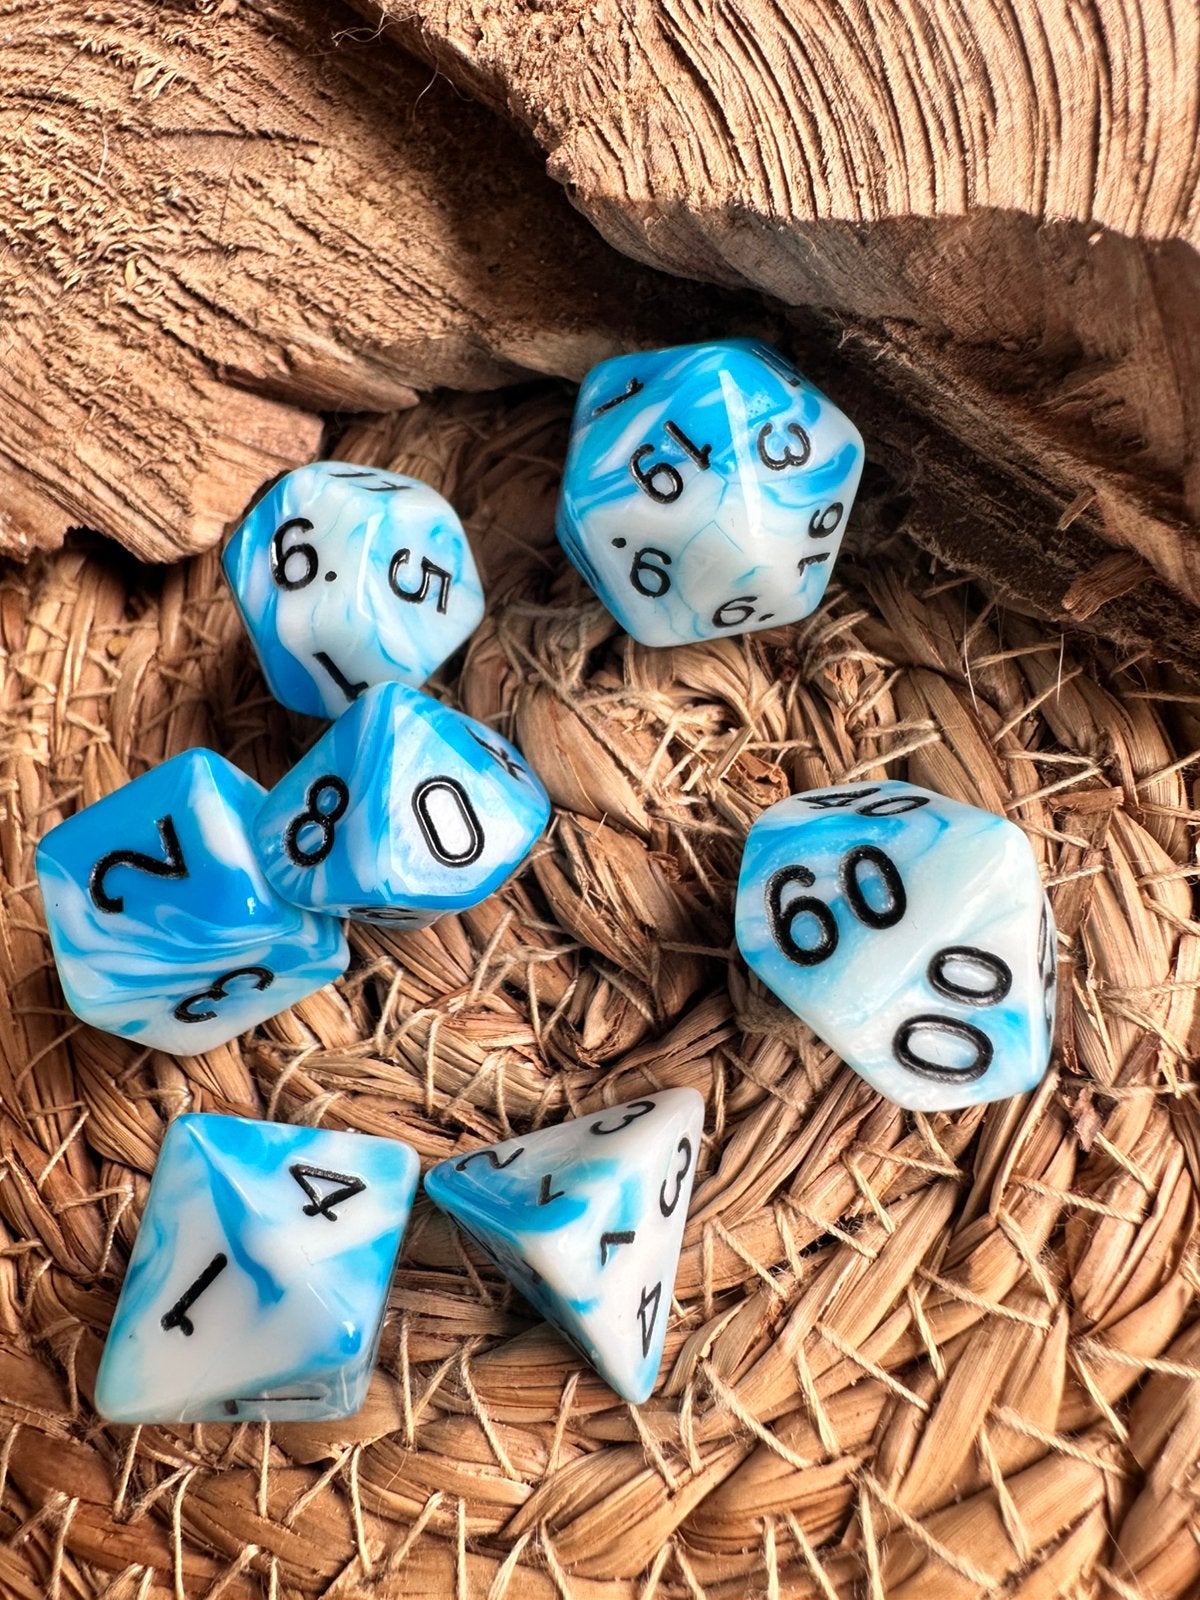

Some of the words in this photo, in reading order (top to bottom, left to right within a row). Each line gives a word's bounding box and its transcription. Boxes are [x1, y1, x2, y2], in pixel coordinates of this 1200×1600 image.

[591, 376, 644, 418] 1
[629, 420, 712, 504] 19
[757, 422, 811, 471] 3
[388, 548, 453, 615] 5
[312, 651, 369, 703] 1
[283, 774, 349, 868] 8
[412, 774, 485, 869] 0
[797, 787, 930, 817] 40
[88, 815, 188, 914] 2
[764, 845, 907, 967] 60
[173, 966, 275, 1023] 3
[590, 1100, 656, 1135] 3
[455, 1147, 525, 1171] 2
[659, 1137, 692, 1218] 3
[289, 1163, 367, 1222] 4
[538, 1174, 565, 1206] 1
[600, 1230, 636, 1266] 1
[160, 1252, 228, 1336] 1
[637, 1281, 662, 1359] 4
